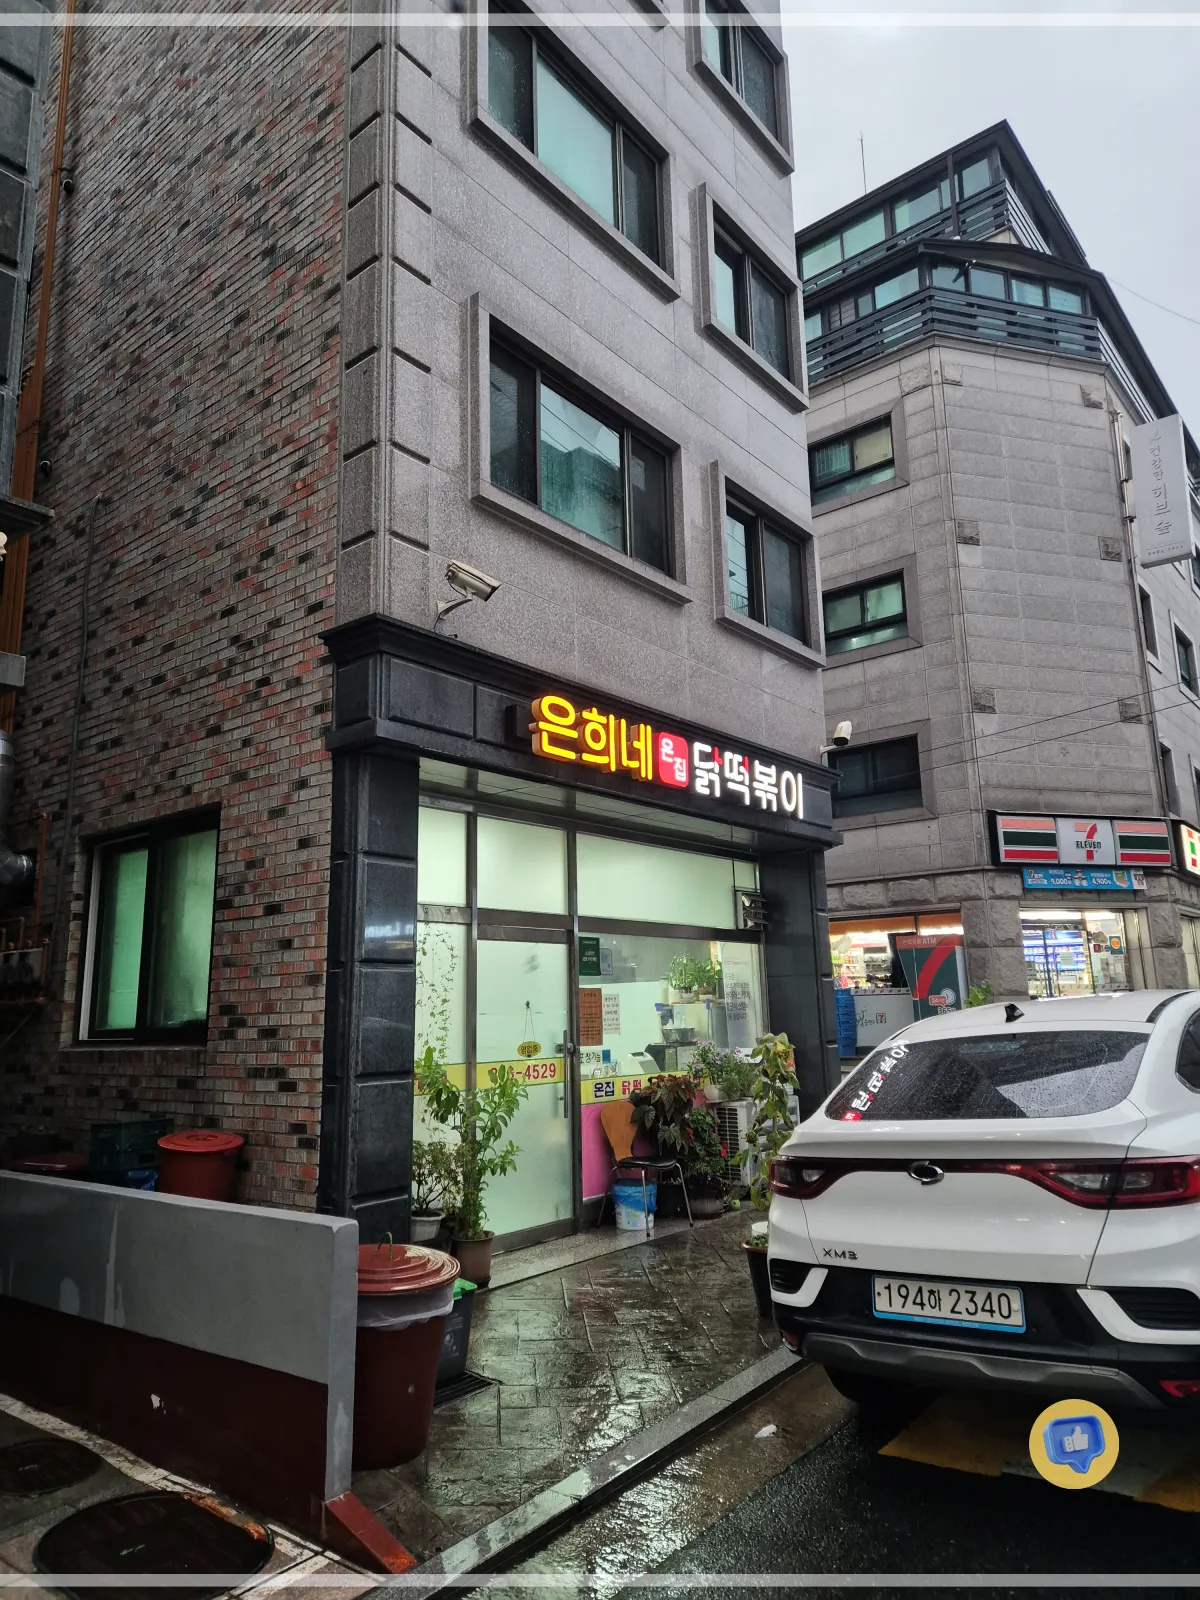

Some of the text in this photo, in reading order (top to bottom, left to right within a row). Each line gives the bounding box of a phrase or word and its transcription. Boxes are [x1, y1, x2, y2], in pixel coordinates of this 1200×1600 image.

[536, 694, 653, 781] 은희네
[693, 741, 804, 820] 닭떡볶이
[520, 1044, 539, 1055] 영업중
[594, 1081, 615, 1099] 온집
[822, 1247, 859, 1261] XM3
[884, 1282, 1012, 1320] 194하 2340
